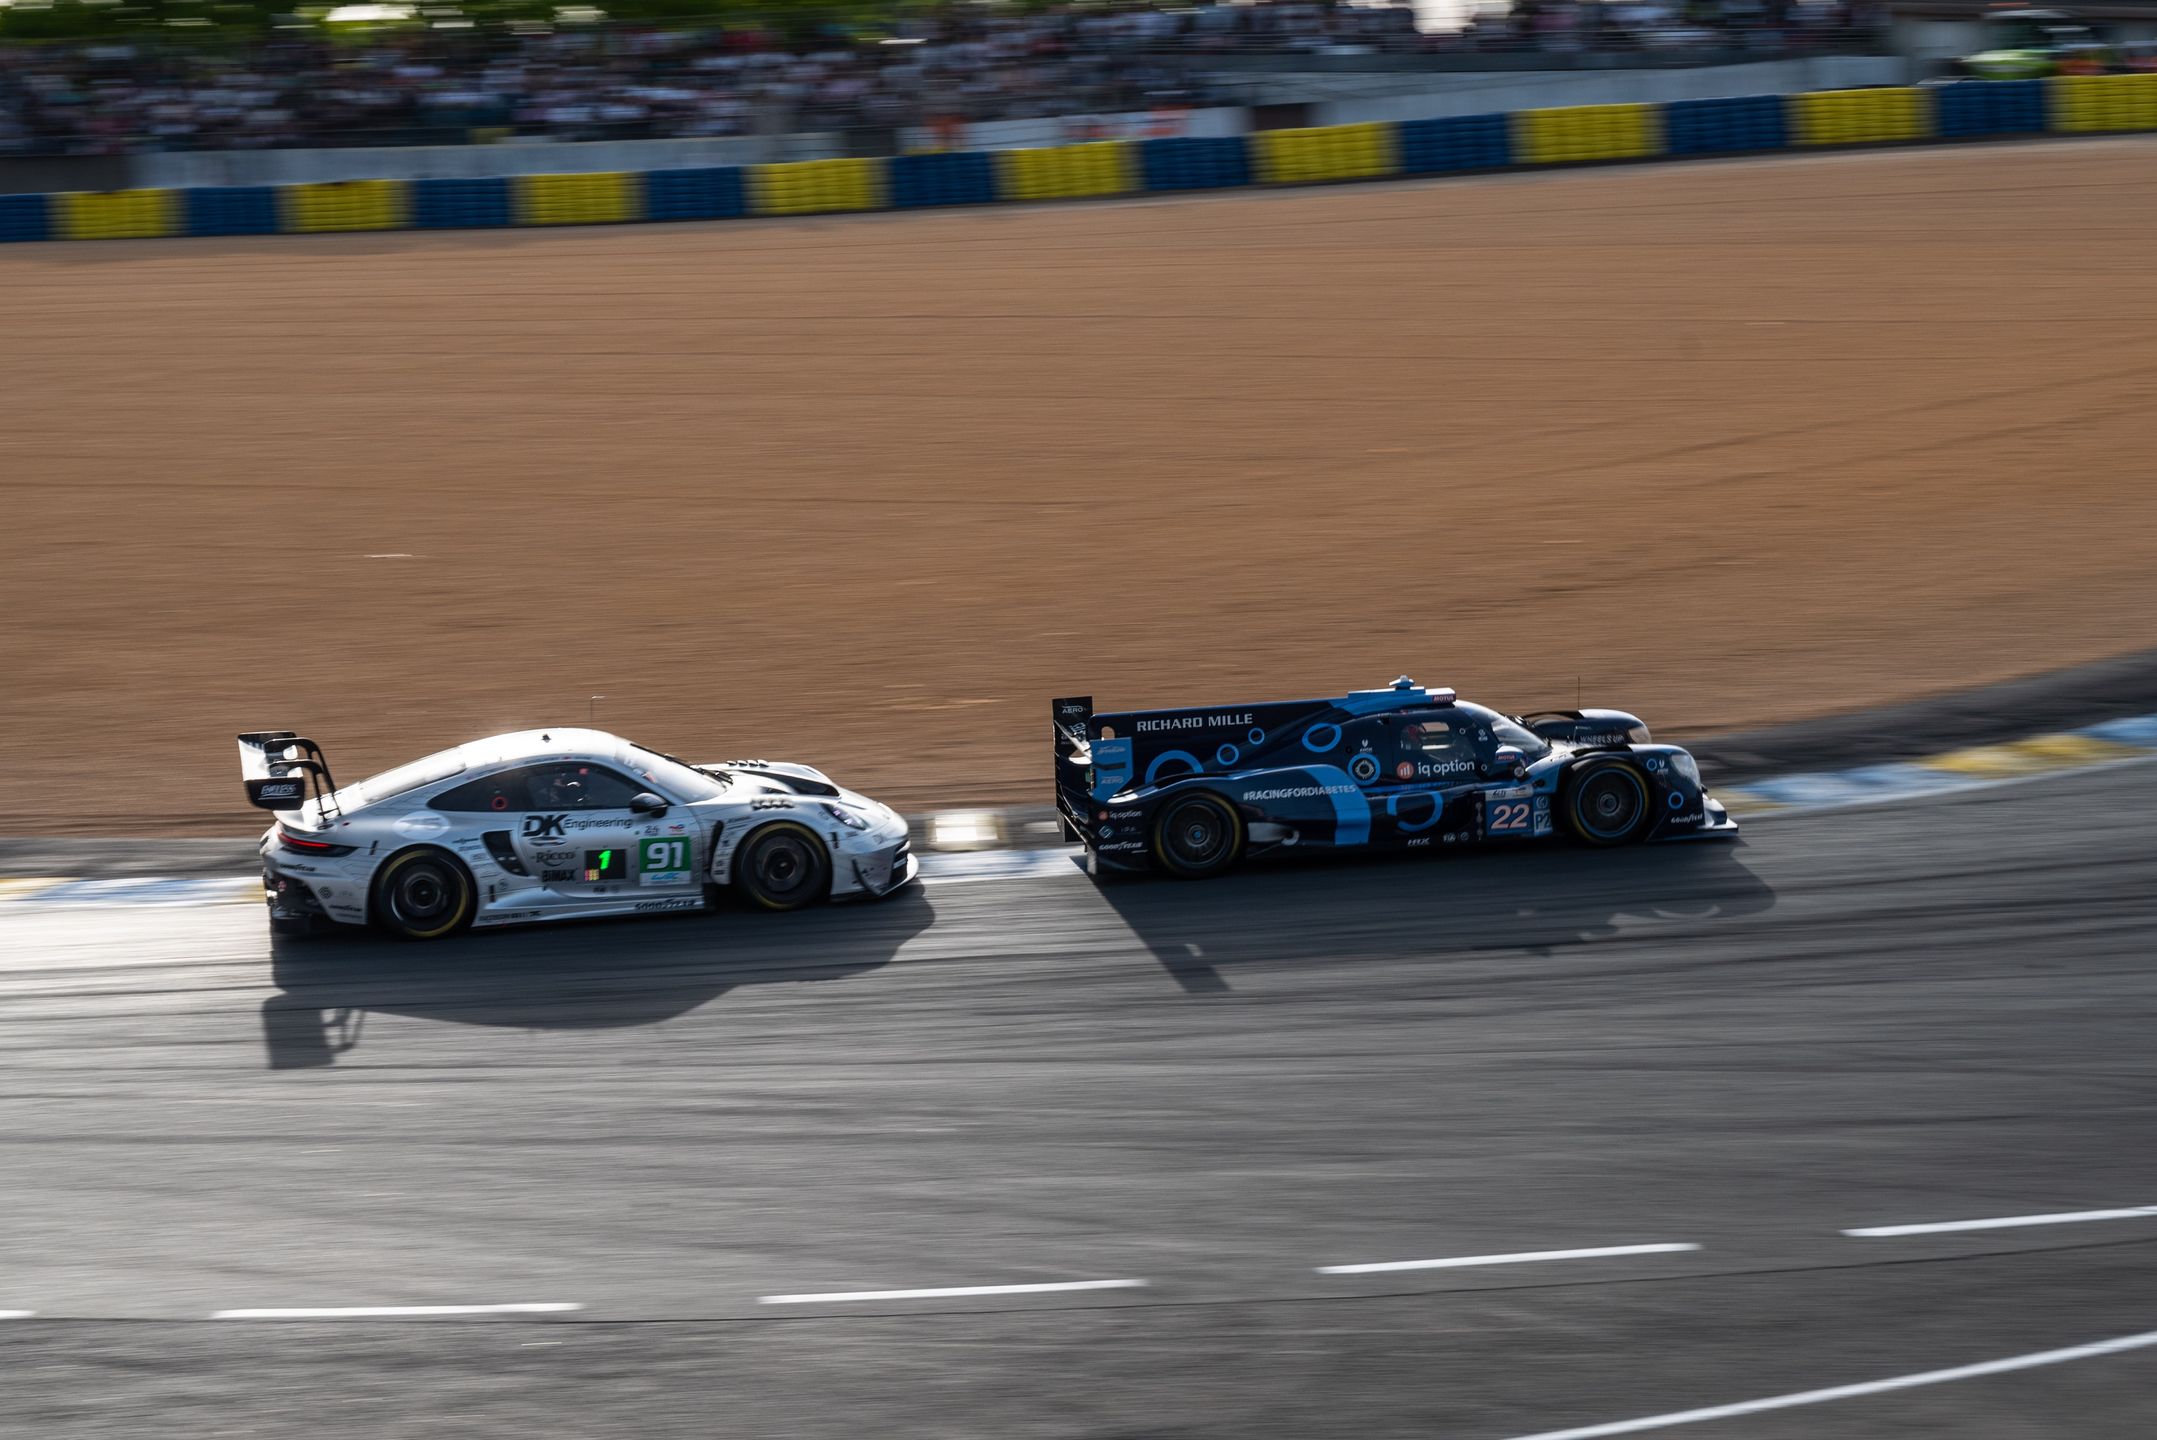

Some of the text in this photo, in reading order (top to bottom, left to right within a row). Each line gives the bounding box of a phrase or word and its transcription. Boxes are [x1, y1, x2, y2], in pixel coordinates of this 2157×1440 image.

[1136, 713, 1253, 732] RICHARD MILLE
[1417, 759, 1475, 777] iq option
[1243, 785, 1357, 800] #RACINGFORDIABETES
[522, 814, 632, 837] DK Engineering
[1491, 803, 1530, 829] 22
[1099, 841, 1143, 850] GOODYEAR
[599, 850, 612, 870] 1
[647, 842, 684, 869] 91
